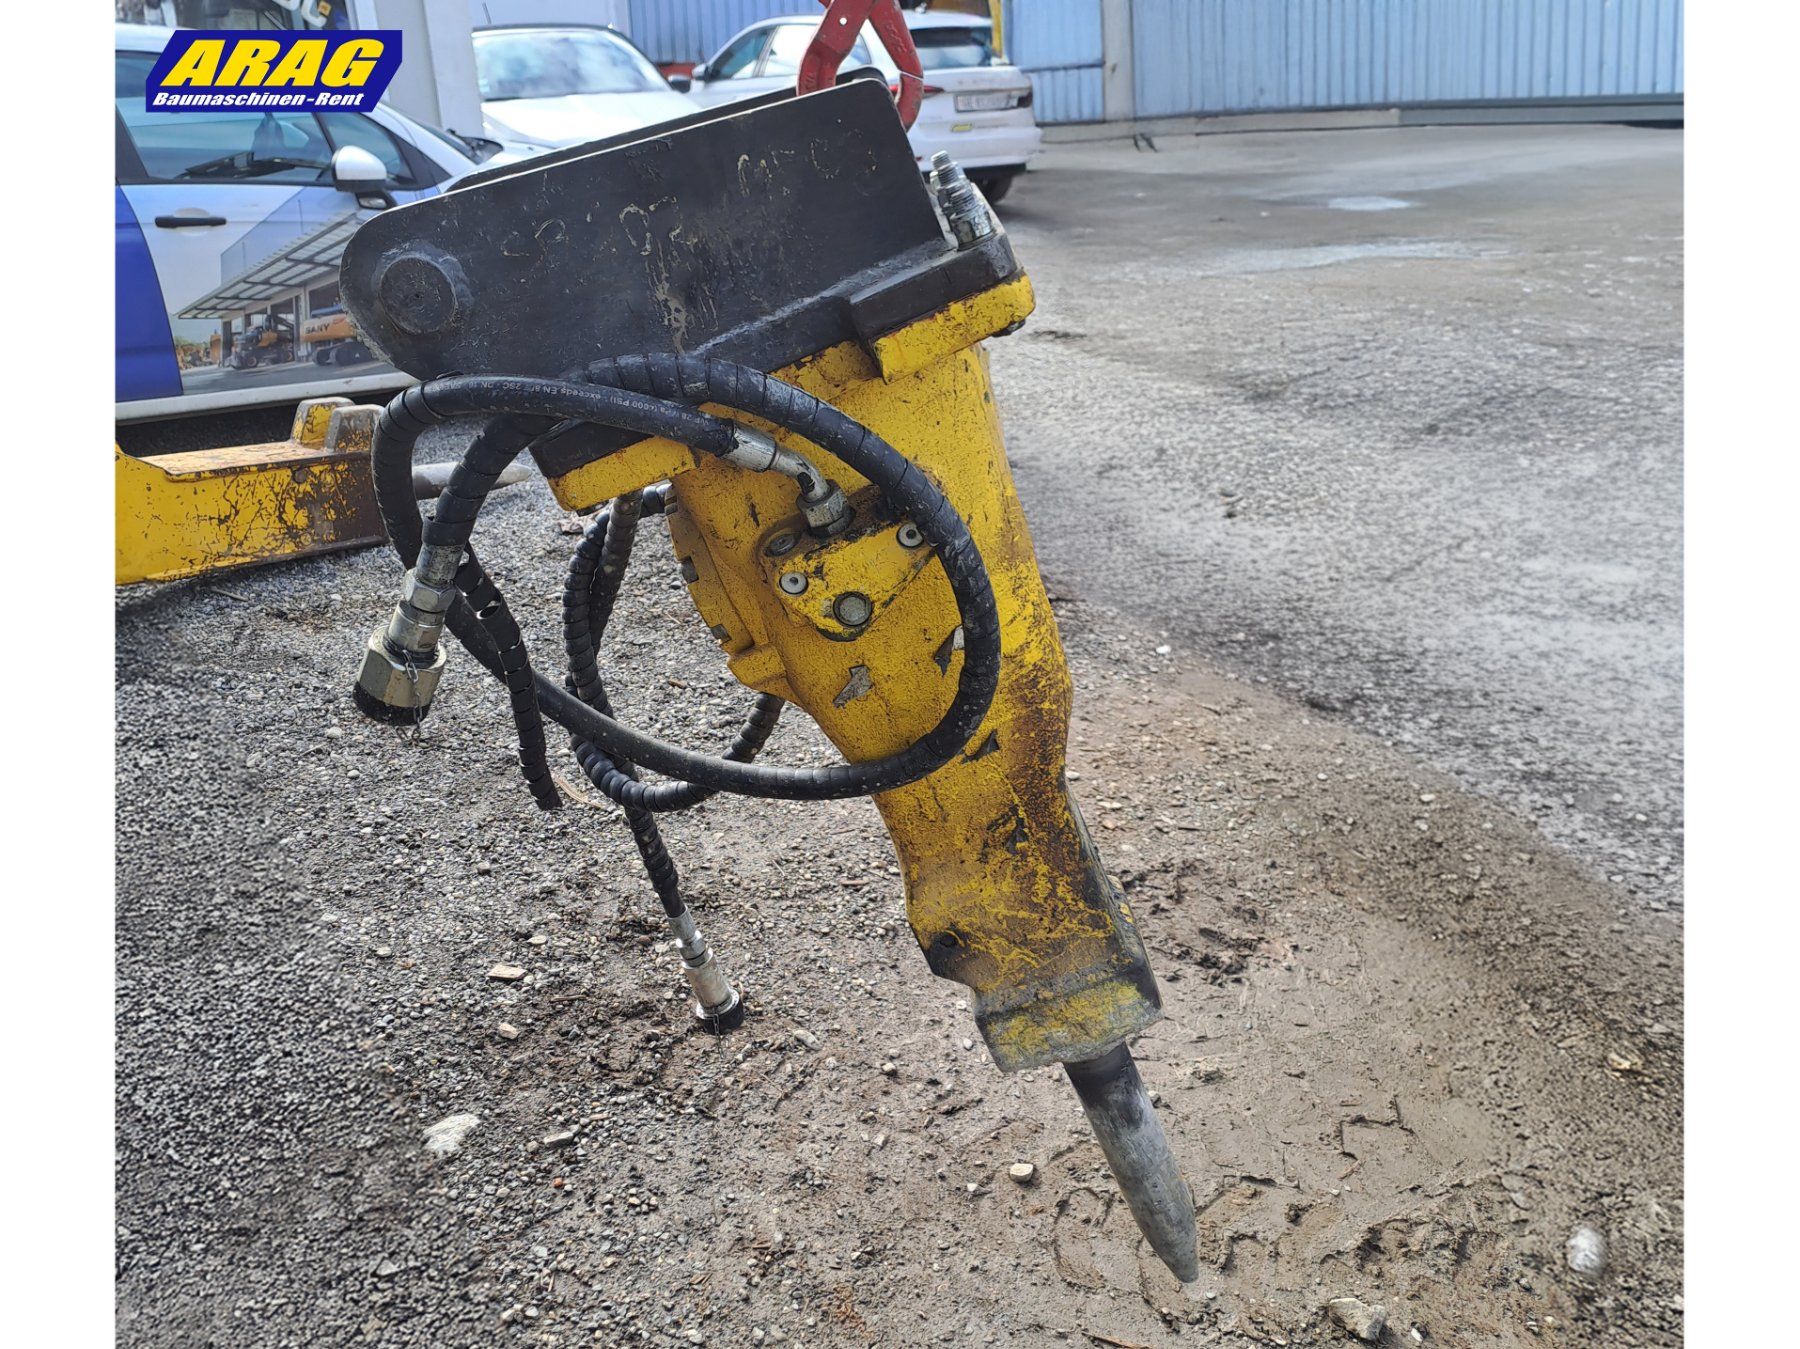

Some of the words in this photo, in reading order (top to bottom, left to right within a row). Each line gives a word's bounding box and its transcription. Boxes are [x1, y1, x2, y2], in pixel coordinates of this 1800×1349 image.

[305, 323, 330, 335] SANY
[543, 385, 557, 394] EN
[560, 387, 601, 400] exceeds
[609, 396, 630, 407] PSI)
[632, 400, 657, 412] (4000
